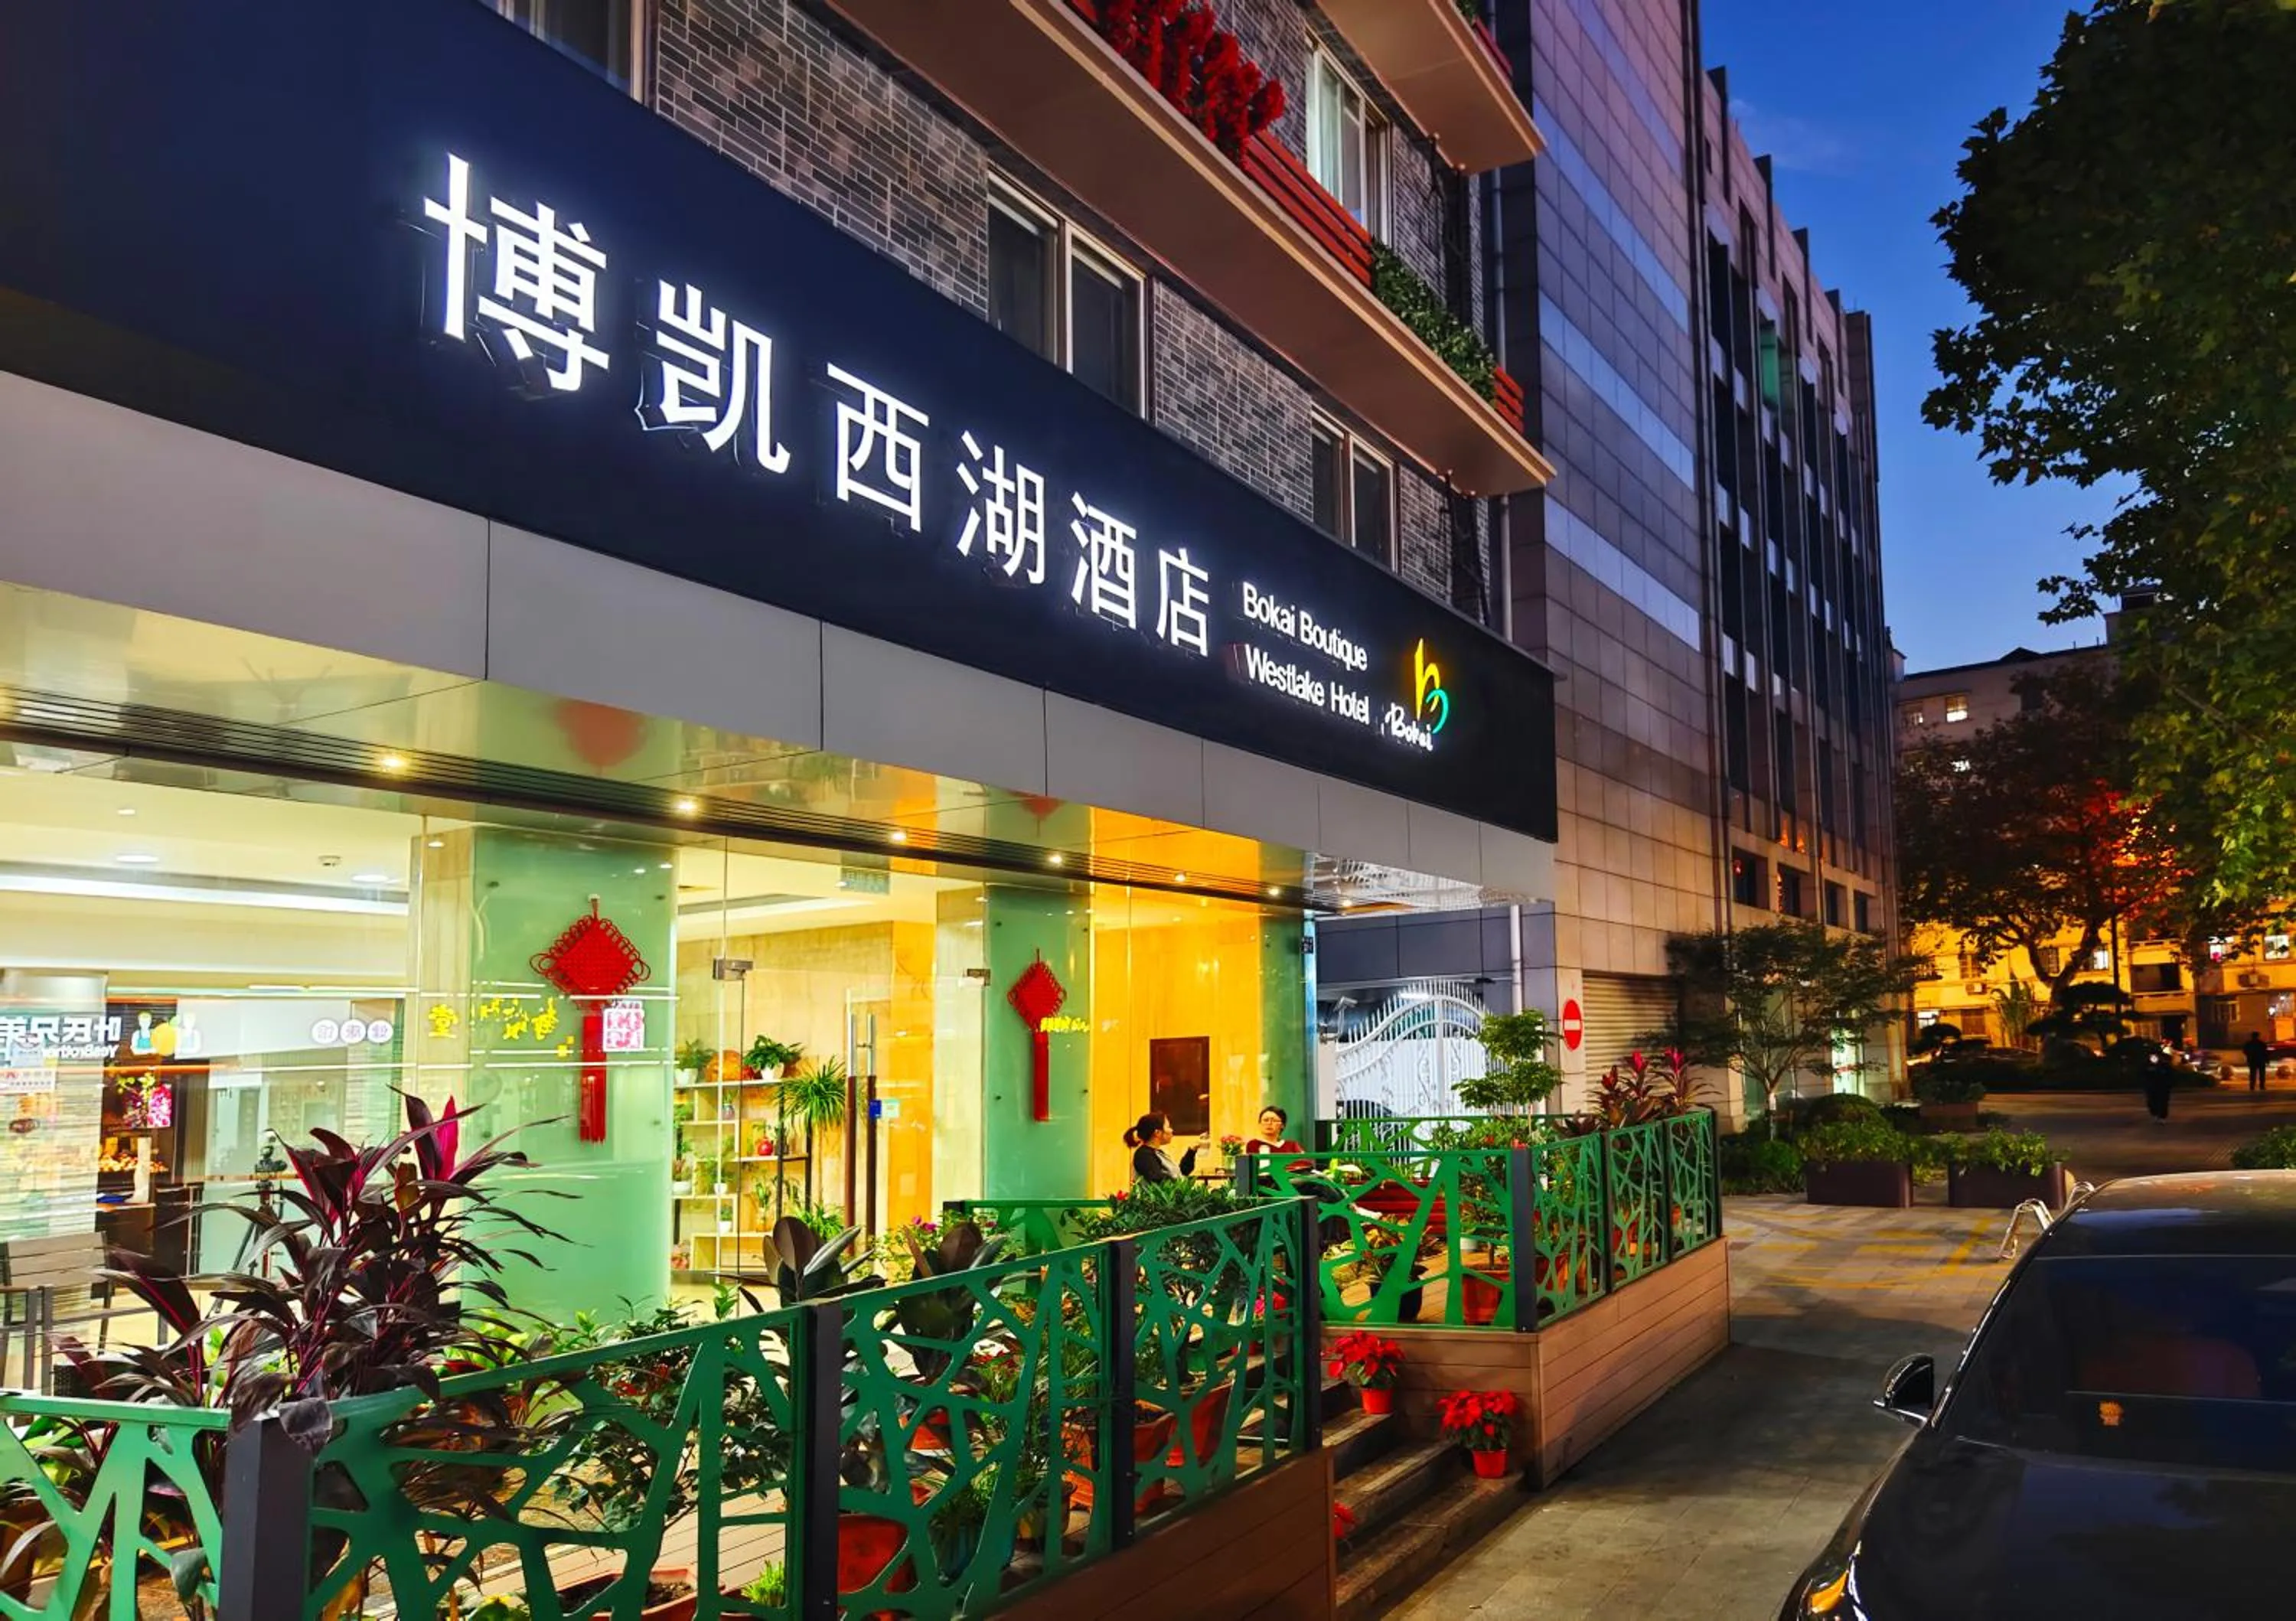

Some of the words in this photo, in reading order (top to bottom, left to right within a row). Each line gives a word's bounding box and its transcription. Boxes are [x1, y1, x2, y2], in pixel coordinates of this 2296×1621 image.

[424, 152, 1210, 657] 博凯西湖酒店
[1242, 581, 1296, 638] Bokai
[1300, 610, 1368, 671] Boutique
[1244, 644, 1326, 706] Westlake
[1330, 681, 1370, 725] Hotel
[1384, 702, 1434, 752] Bokai
